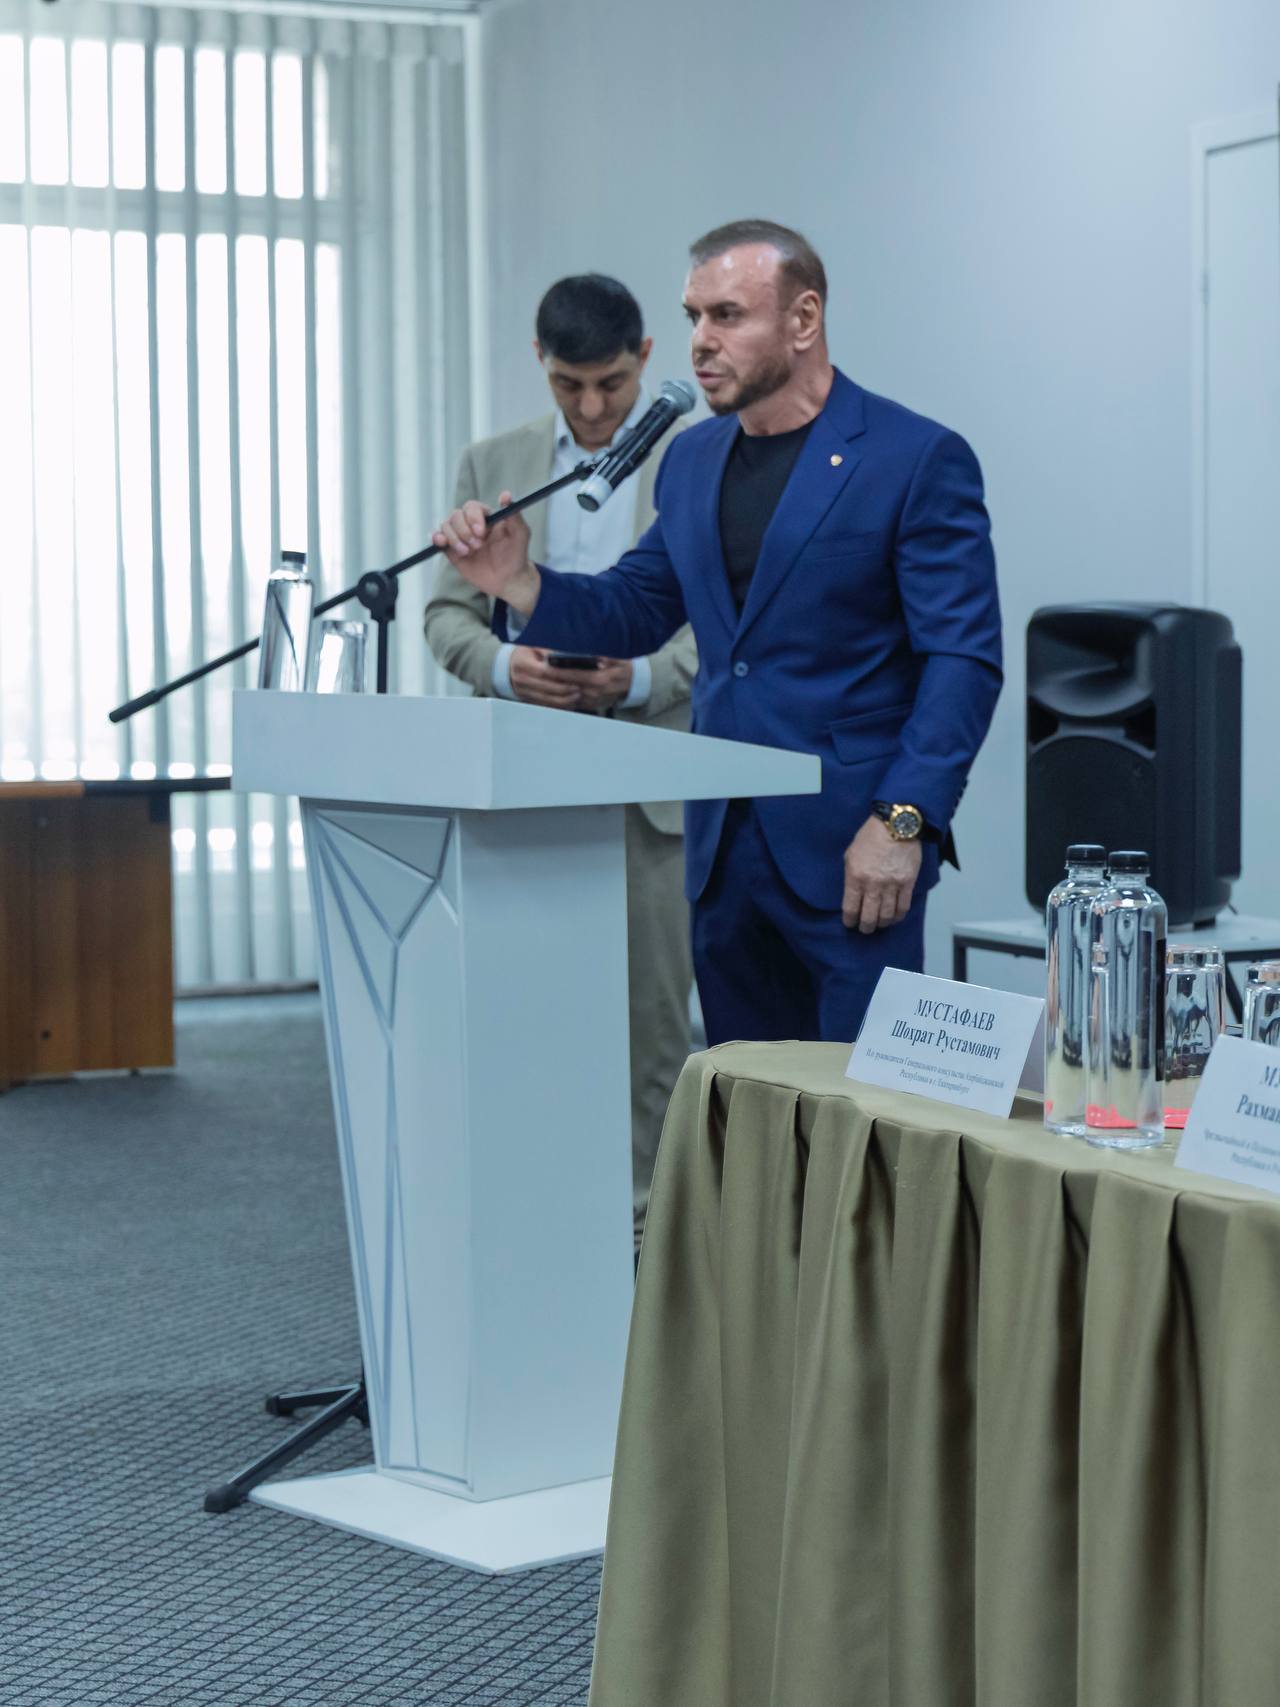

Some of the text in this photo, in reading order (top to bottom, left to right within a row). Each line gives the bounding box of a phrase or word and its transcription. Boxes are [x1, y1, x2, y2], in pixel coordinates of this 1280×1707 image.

[914, 999, 996, 1031] МУСТАФАЕВ
[891, 1019, 1001, 1060] Шохрат Рустамович
